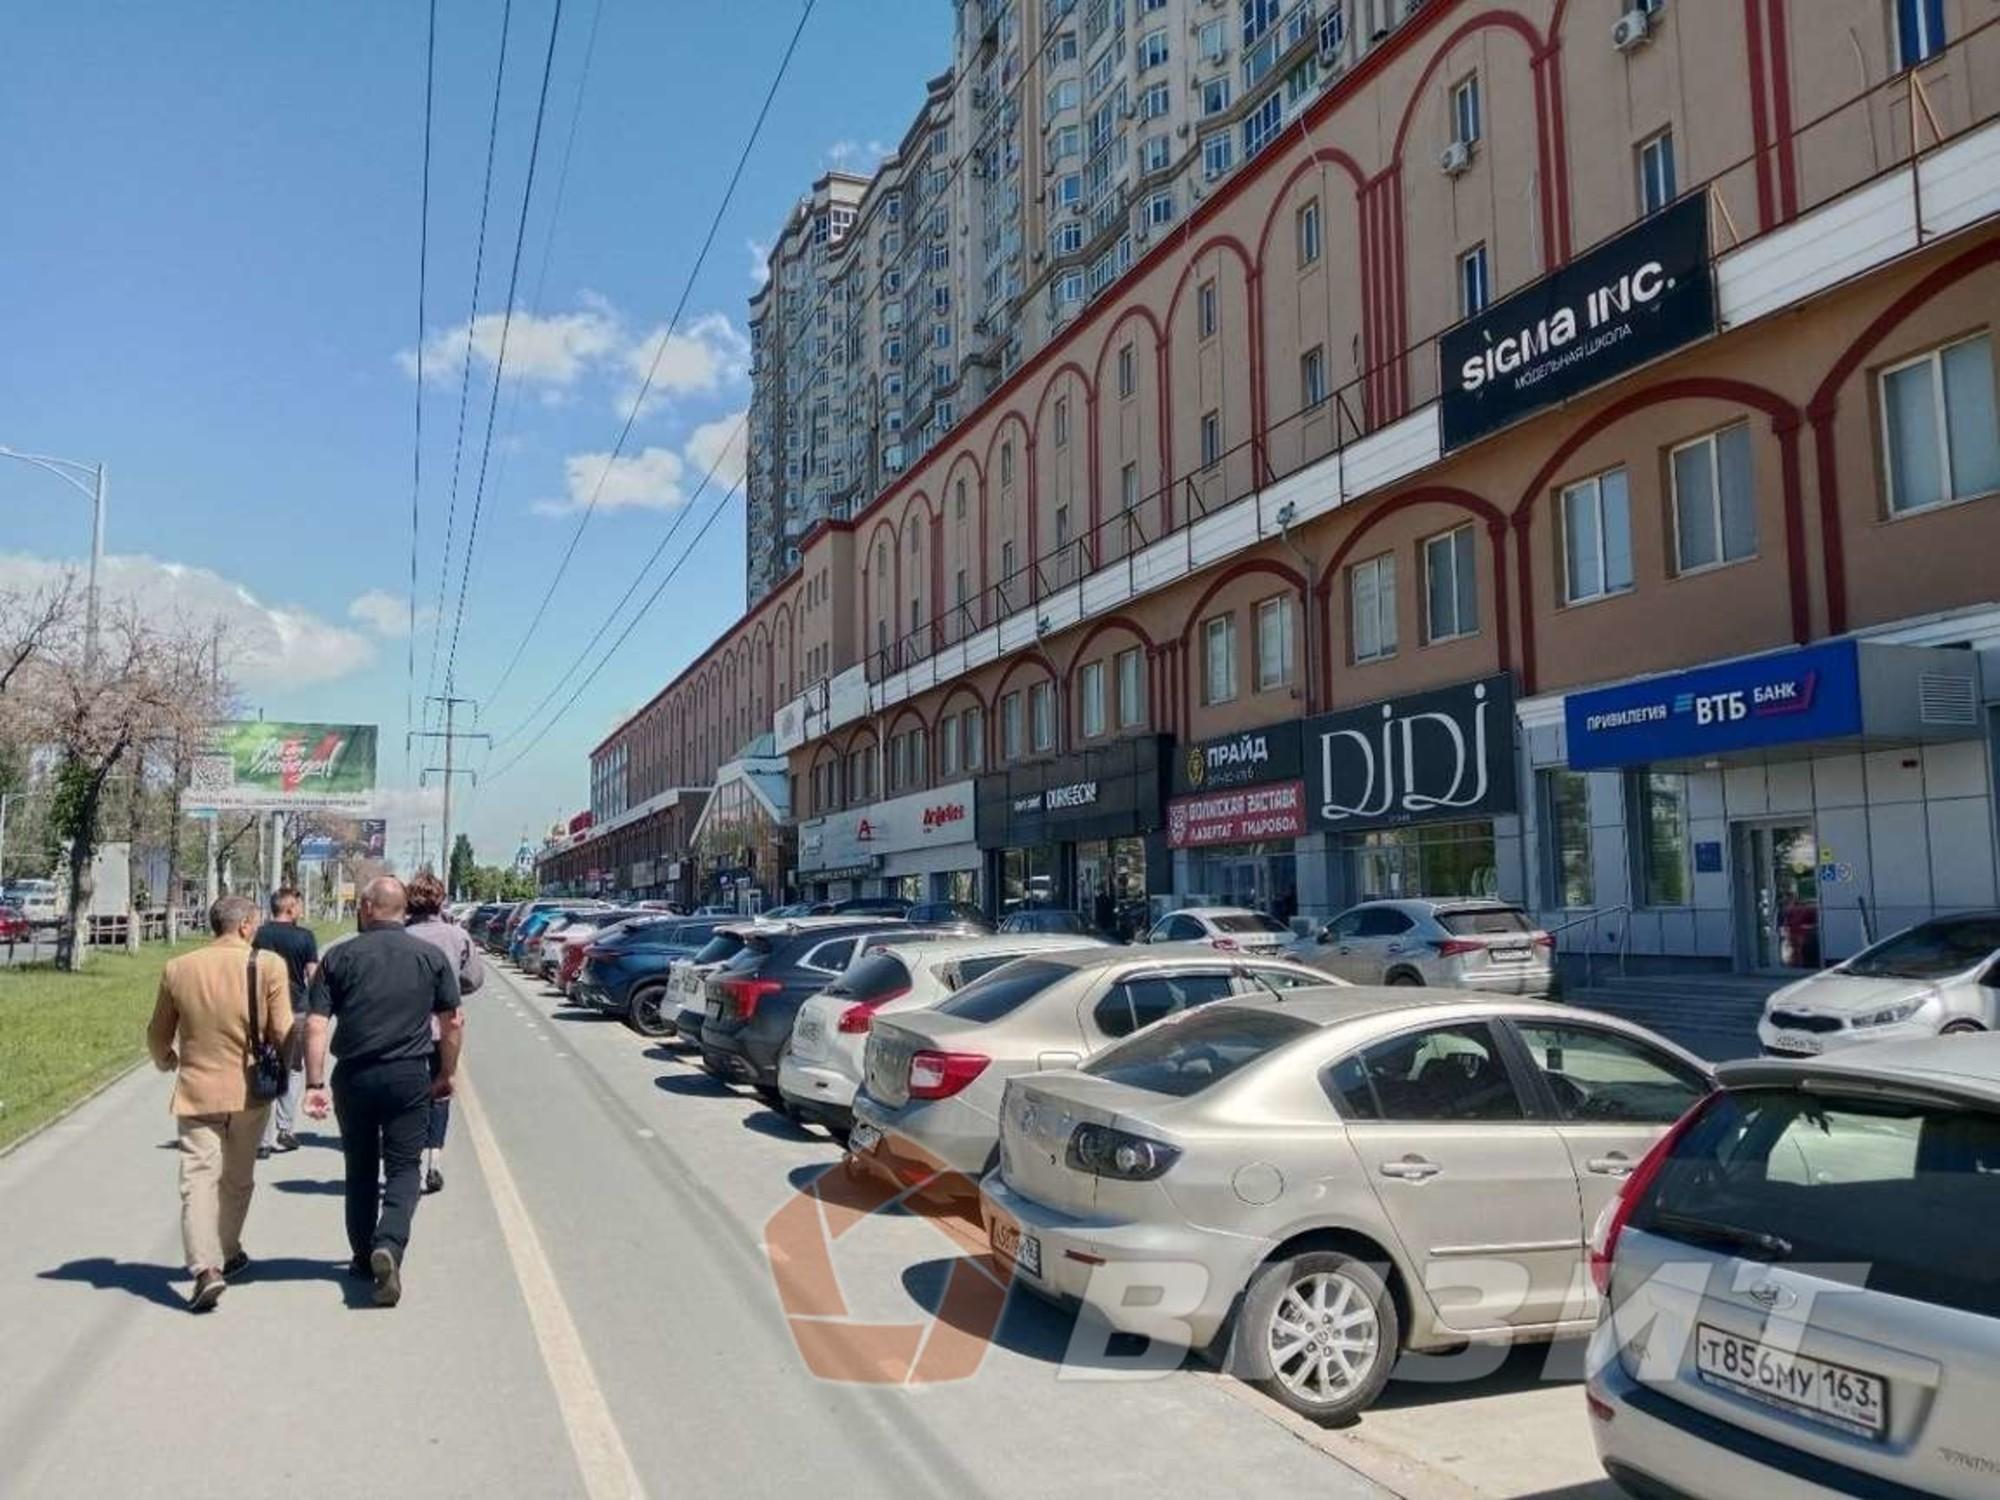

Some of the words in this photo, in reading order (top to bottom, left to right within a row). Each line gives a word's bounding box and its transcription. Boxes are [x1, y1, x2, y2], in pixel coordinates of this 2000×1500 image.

[1514, 346, 1585, 391] МОДЕЛЬНАЯ
[1584, 323, 1633, 357] ШКОЛА
[1586, 704, 1668, 732] ПРИВИЛЕГИЯ
[1695, 691, 1747, 725] ВТБ
[1753, 682, 1797, 703] БАНК
[1207, 734, 1269, 769] ПРАЙД
[1240, 816, 1298, 836] ГИДРОБОЛ
[1707, 1339, 1814, 1398] Т856МУ
[1822, 1369, 1870, 1408] 163
